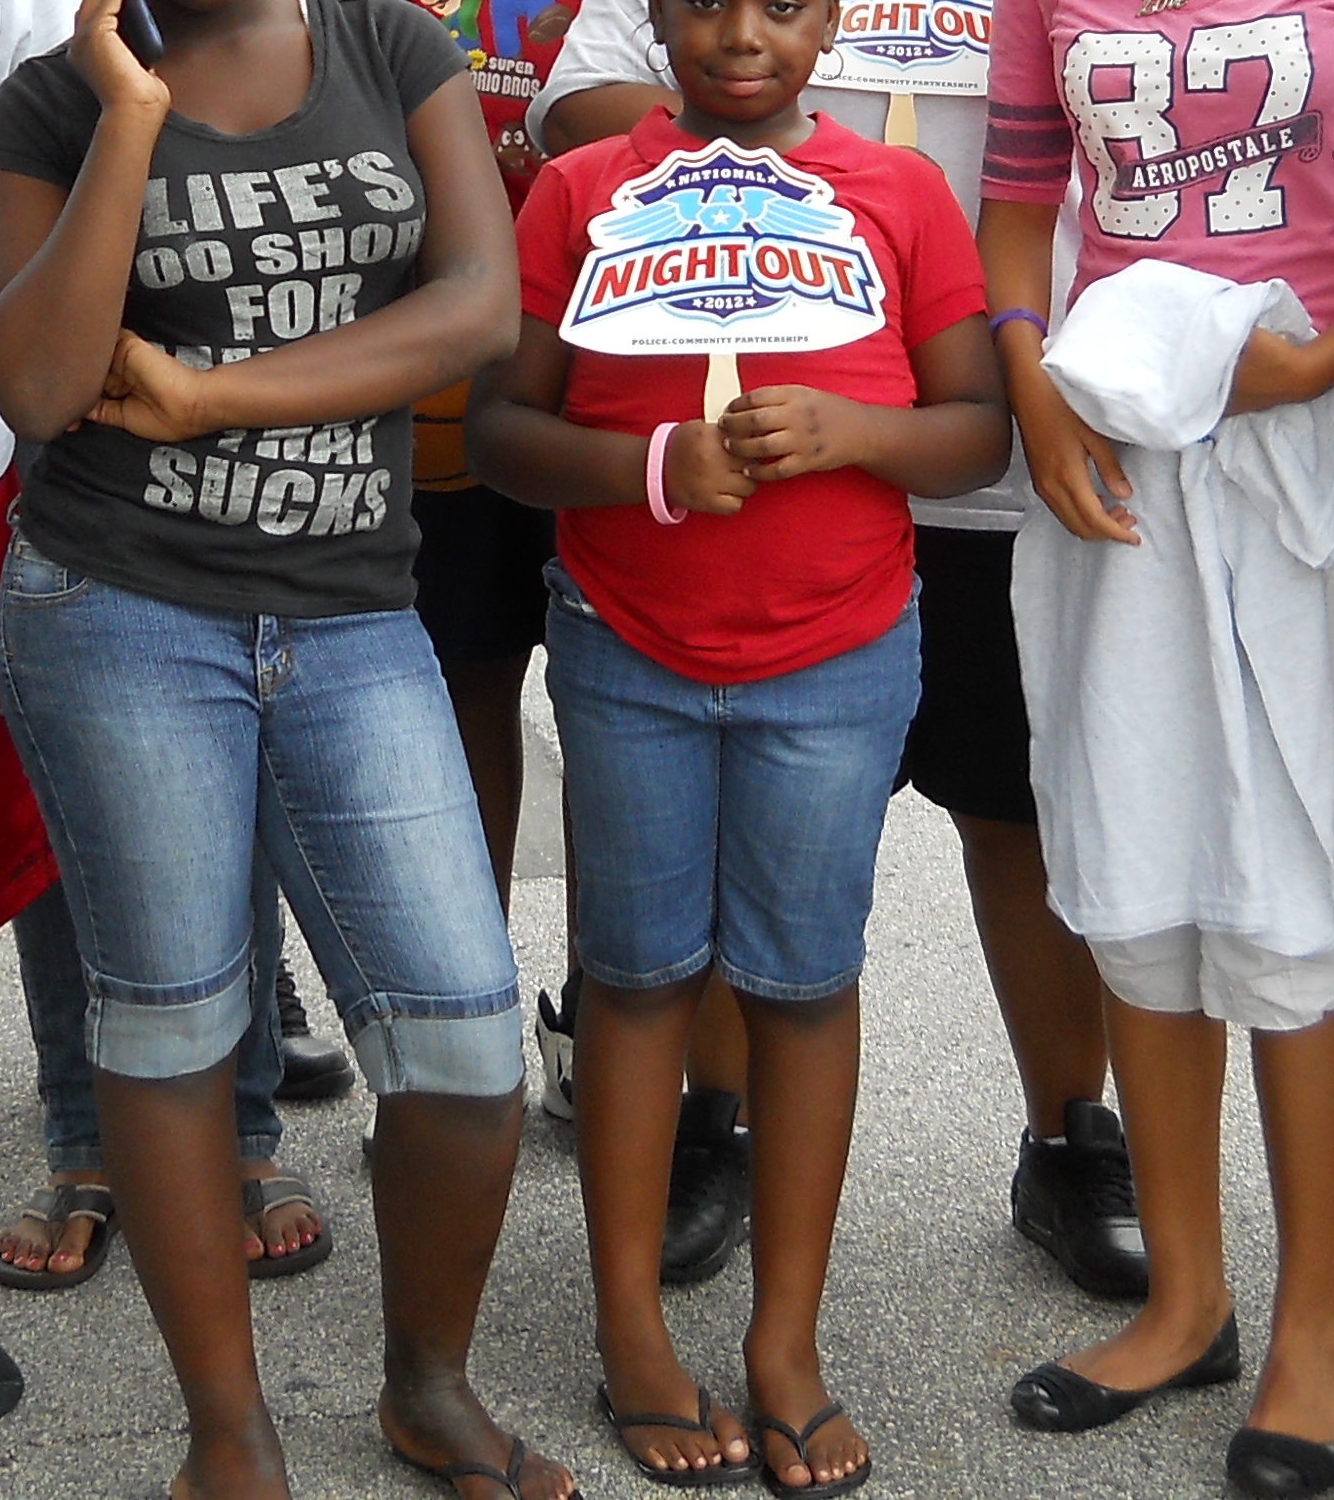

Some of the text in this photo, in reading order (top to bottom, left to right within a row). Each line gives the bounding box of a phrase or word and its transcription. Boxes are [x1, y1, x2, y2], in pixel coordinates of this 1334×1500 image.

[842, 3, 992, 44] GHT OU
[488, 56, 534, 75] SUPER
[886, 45, 922, 57] 2012
[911, 79, 979, 89] PARTNERSHIPS
[1062, 12, 1315, 242] 87
[143, 150, 415, 238] LIFE'S
[677, 168, 767, 186] NATIONAL
[136, 218, 423, 289] OO SHOR
[589, 243, 855, 307] NIGHT OUT
[225, 273, 363, 341] FOR
[703, 295, 745, 309] 2012
[734, 335, 810, 344] PARTNERSHIPS
[143, 445, 392, 536] SUCKS
